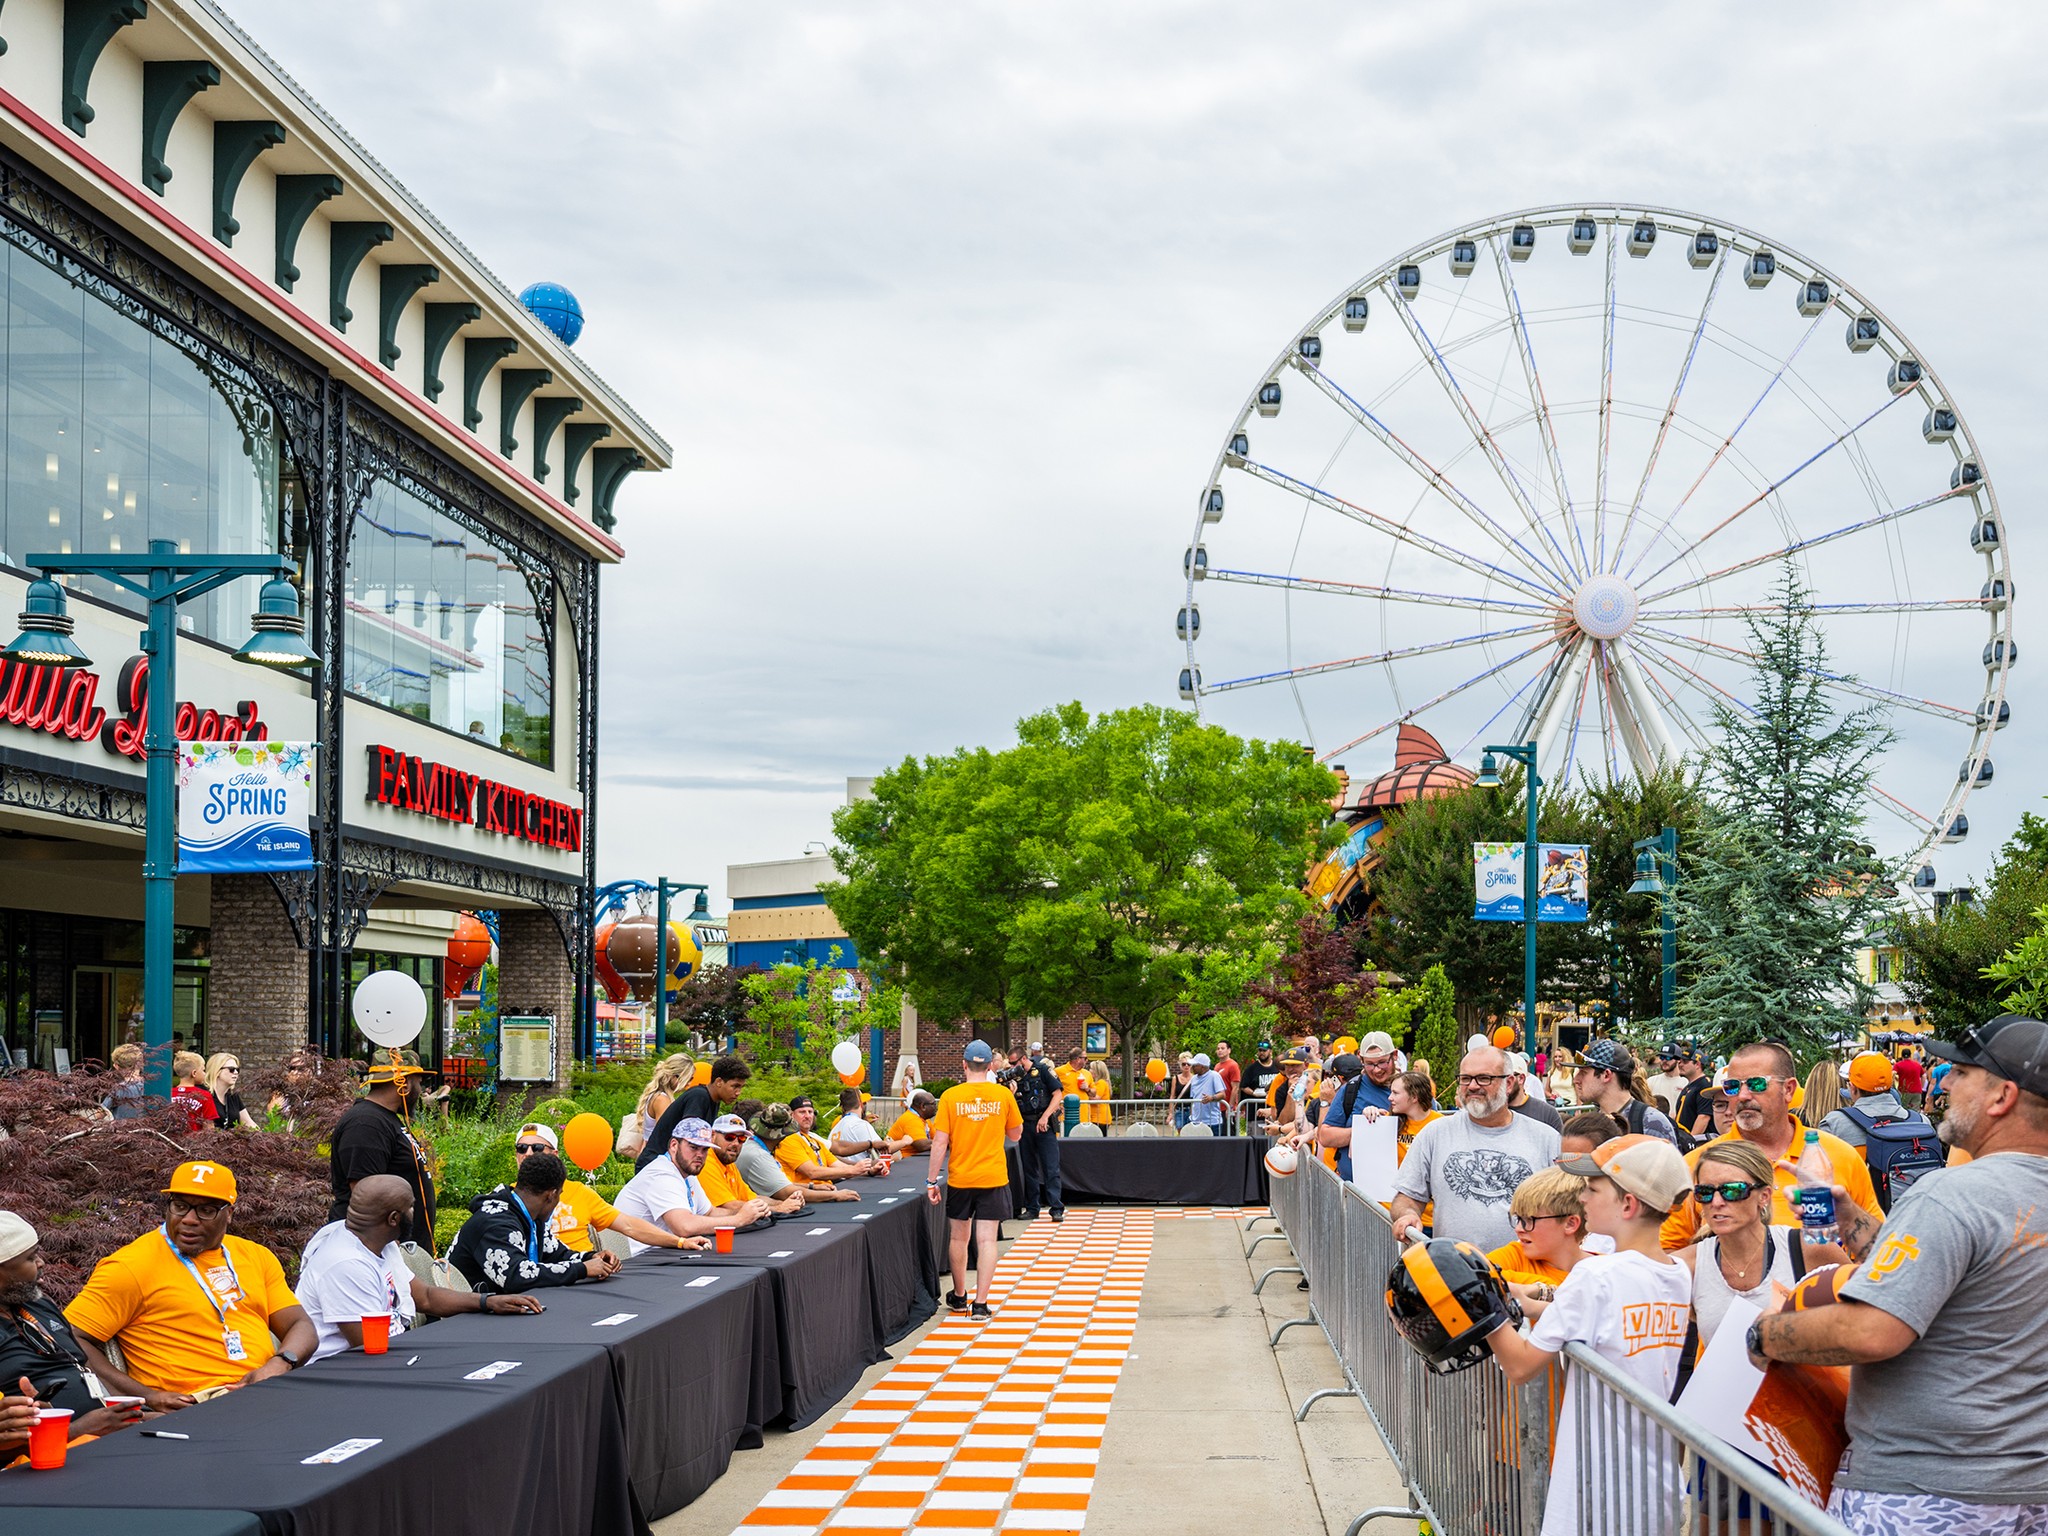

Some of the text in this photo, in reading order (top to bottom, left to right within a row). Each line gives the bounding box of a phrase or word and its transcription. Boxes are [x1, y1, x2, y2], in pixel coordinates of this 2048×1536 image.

[229, 772, 268, 786] Hello
[203, 783, 287, 824] SPRING
[369, 745, 583, 852] FAMILY KITCHEN
[256, 842, 300, 851] THE ISLAND
[1485, 871, 1517, 888] SPRING
[696, 927, 728, 943] TIM
[956, 1102, 1001, 1116] TENNESSEE
[192, 1165, 214, 1183] T
[1801, 1203, 1827, 1214] 00%
